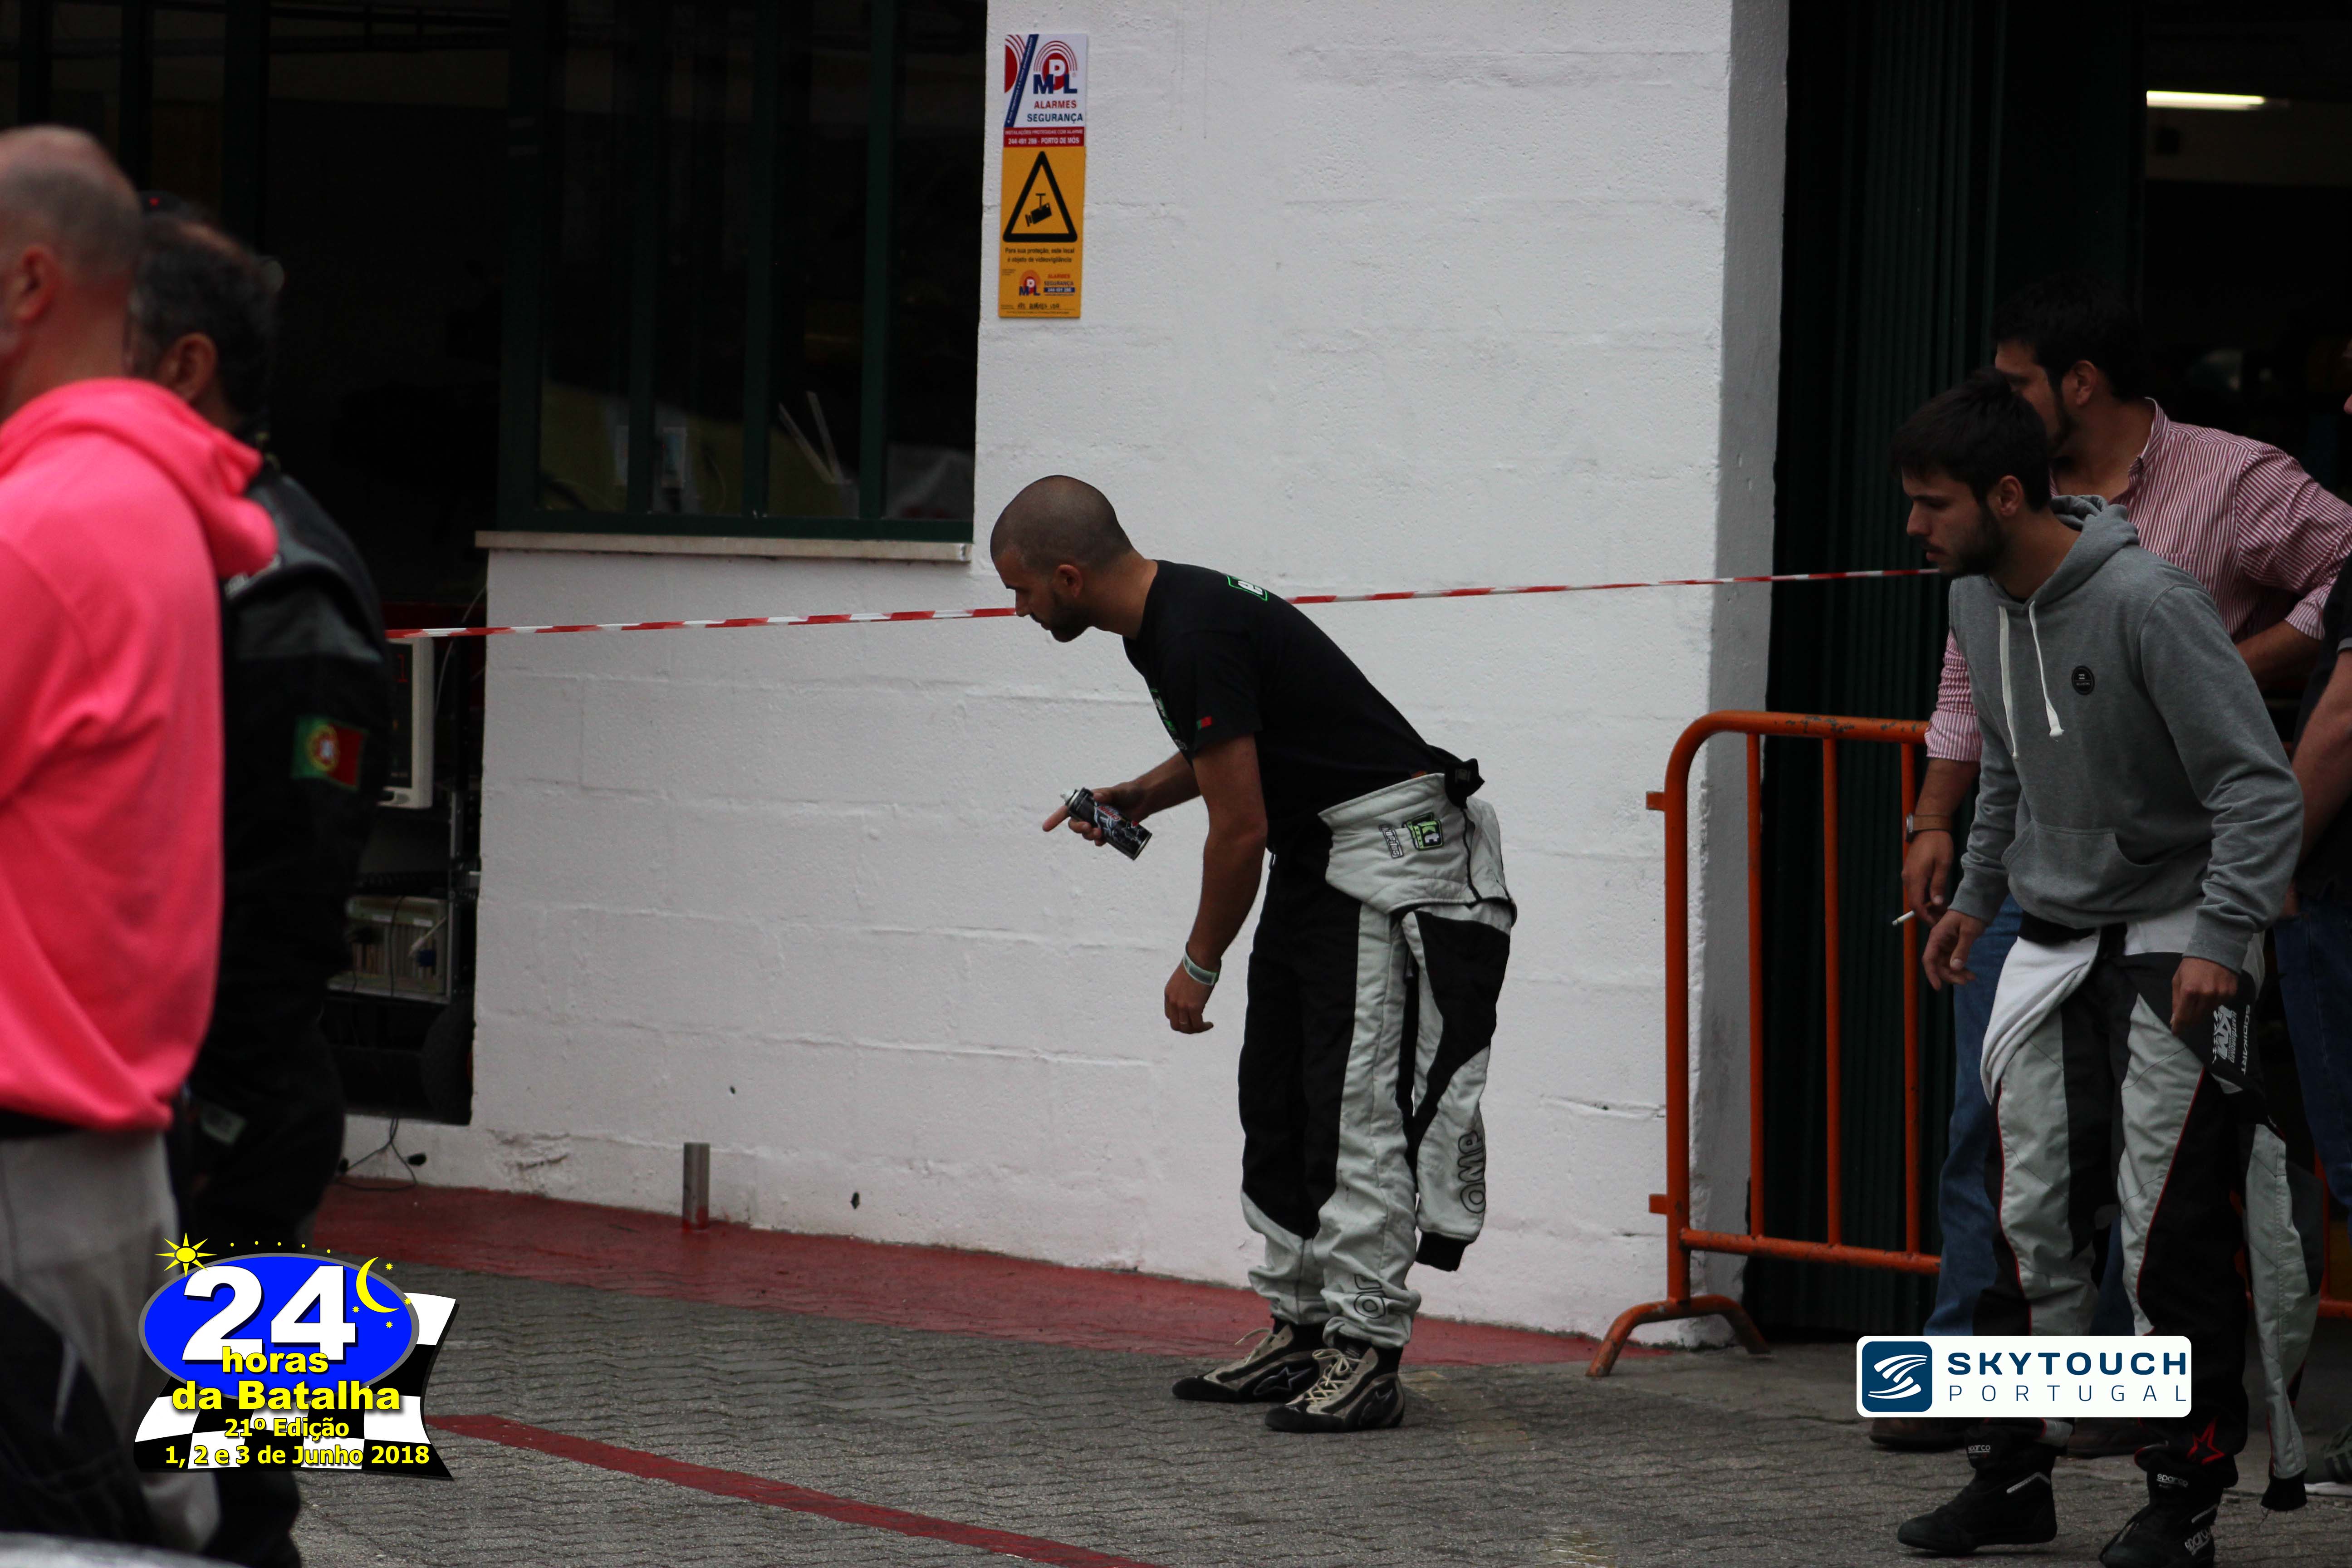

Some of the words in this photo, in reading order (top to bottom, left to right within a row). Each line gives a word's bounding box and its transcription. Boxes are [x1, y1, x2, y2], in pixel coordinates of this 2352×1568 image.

[1034, 100, 1077, 109] ALARMES
[1027, 113, 1083, 123] SEGURANÇA
[2241, 1004, 2250, 1076] SODIKART
